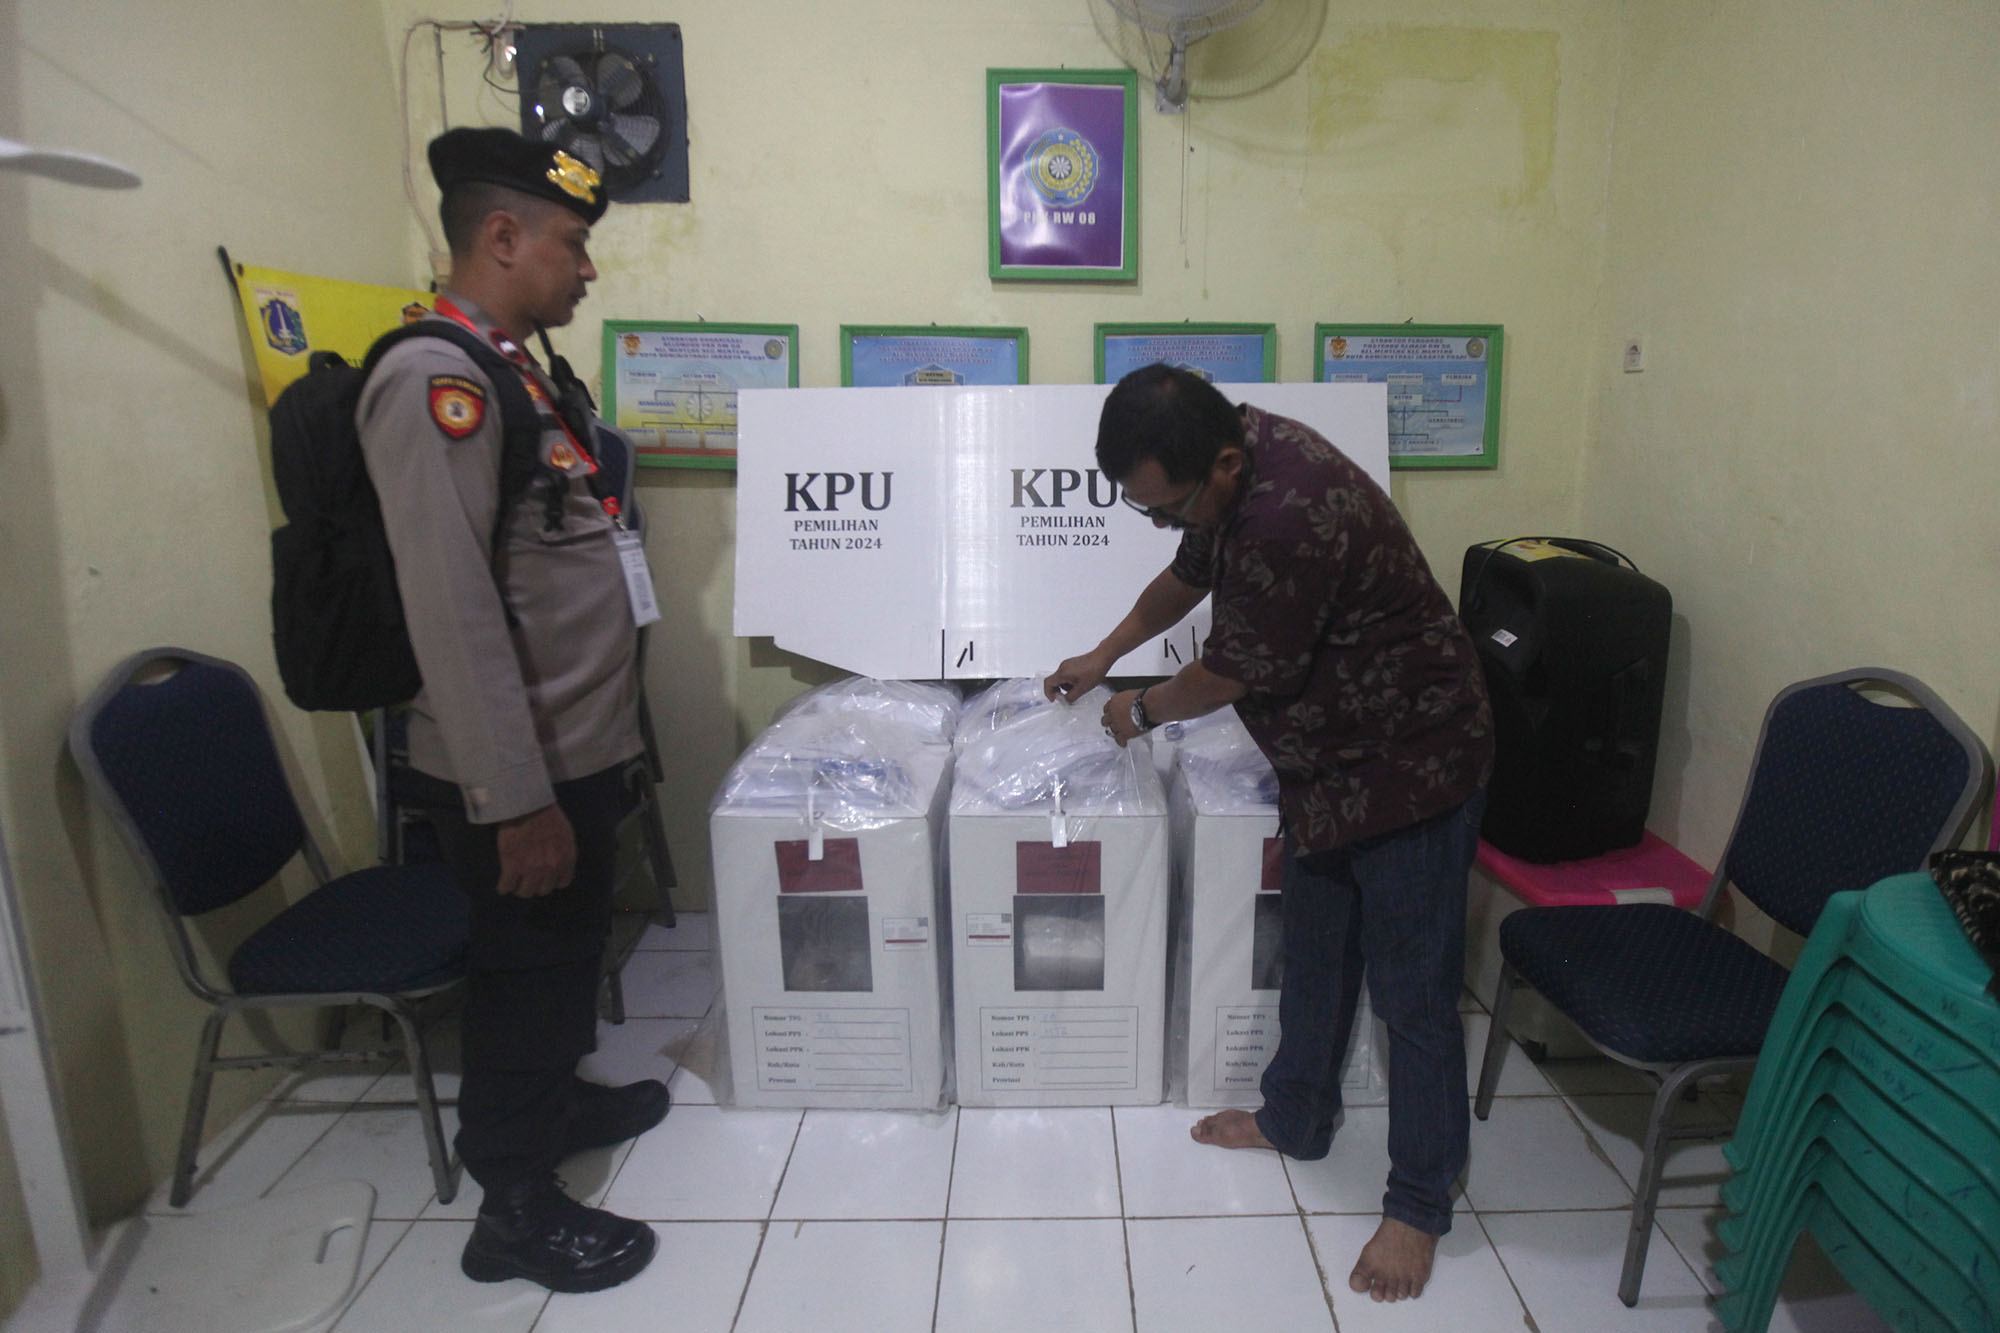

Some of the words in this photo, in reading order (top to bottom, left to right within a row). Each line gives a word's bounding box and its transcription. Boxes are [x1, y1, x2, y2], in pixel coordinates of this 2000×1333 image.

[1053, 211, 1075, 224] RW
[1079, 212, 1096, 225] 08
[784, 472, 894, 512] KPU
[1010, 469, 1118, 508] KPU
[794, 519, 879, 532] PEMILIHAN
[1021, 516, 1105, 528] PEMILIHAN
[789, 538, 841, 550] TAHUN
[845, 537, 883, 550] 2024
[1016, 534, 1068, 546] TAHUN
[1072, 534, 1110, 546] 2024
